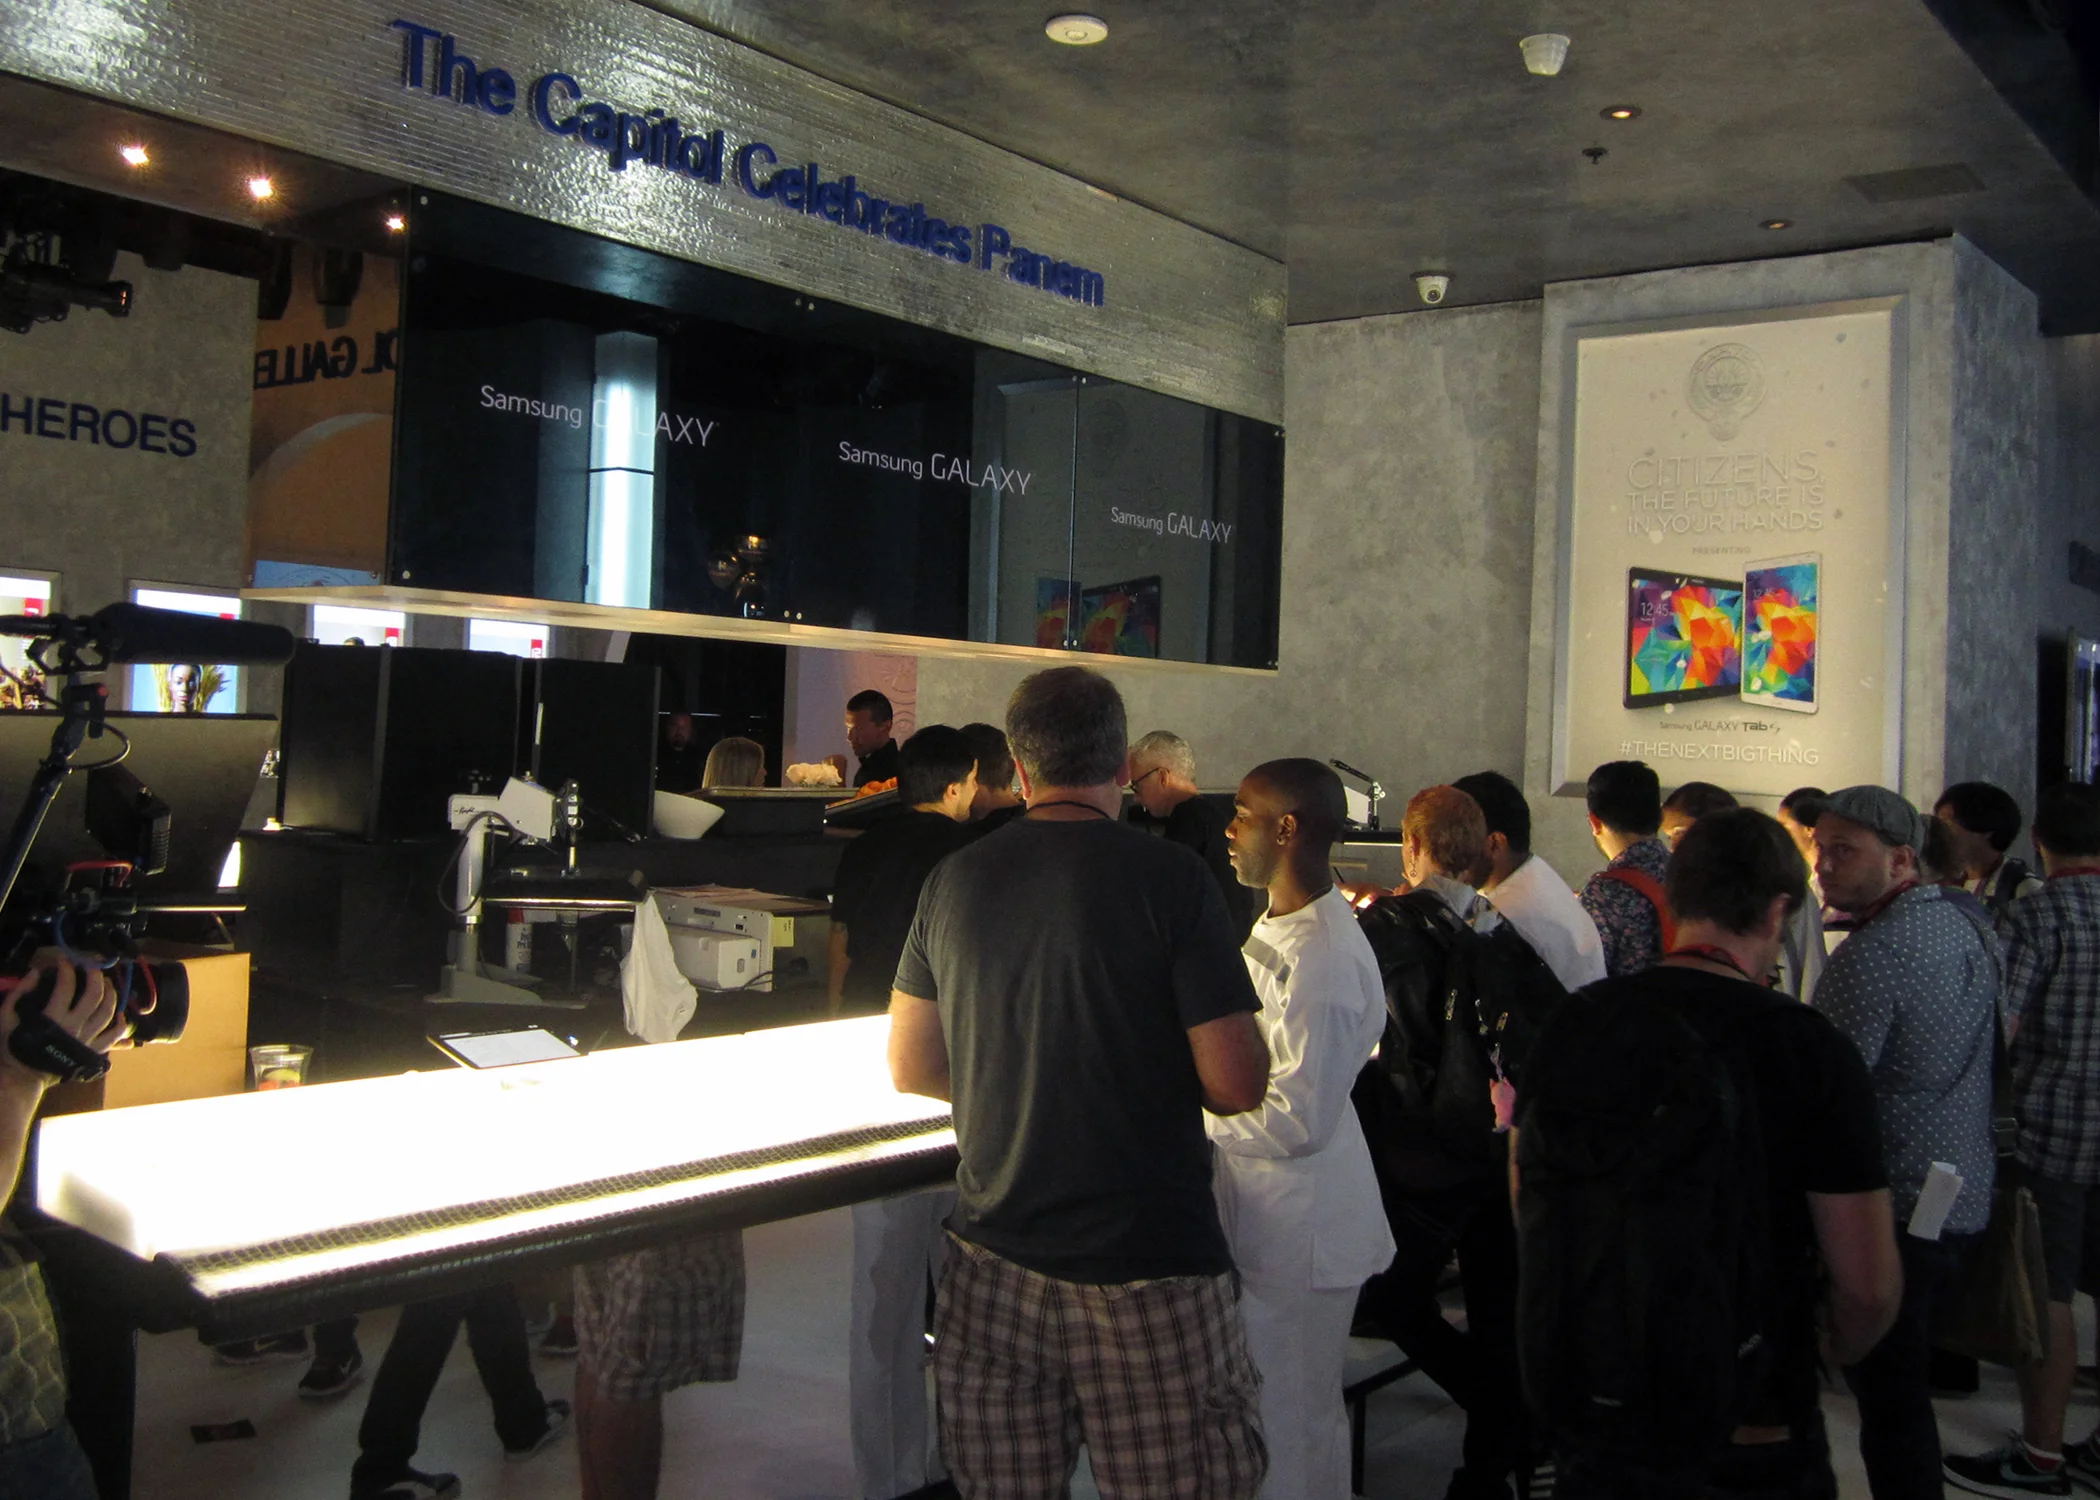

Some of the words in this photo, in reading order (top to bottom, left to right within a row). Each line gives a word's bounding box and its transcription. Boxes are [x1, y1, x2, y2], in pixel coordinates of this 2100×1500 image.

[390, 19, 517, 115] The
[529, 72, 725, 185] Capitol
[733, 142, 972, 264] Celebrates
[976, 223, 1105, 307] Panem
[0, 392, 197, 458] HEROES
[480, 385, 582, 429] Samsung
[592, 399, 714, 447] GLAXY
[839, 441, 923, 480] Samsung
[931, 453, 1031, 495] GALAXY
[1628, 490, 1677, 511] THE
[1683, 486, 1790, 509] FUTURE
[1801, 484, 1824, 506] IS
[1111, 506, 1163, 535] Samsung
[1167, 512, 1232, 543] GALAXY
[1628, 516, 1650, 534] IN
[1657, 513, 1725, 534] YOUR
[1732, 510, 1823, 532] HANDS
[1694, 719, 1739, 732] GALAXY
[1743, 721, 1768, 732] Tab
[1619, 740, 1819, 765] #THENEXTBIGTHING
